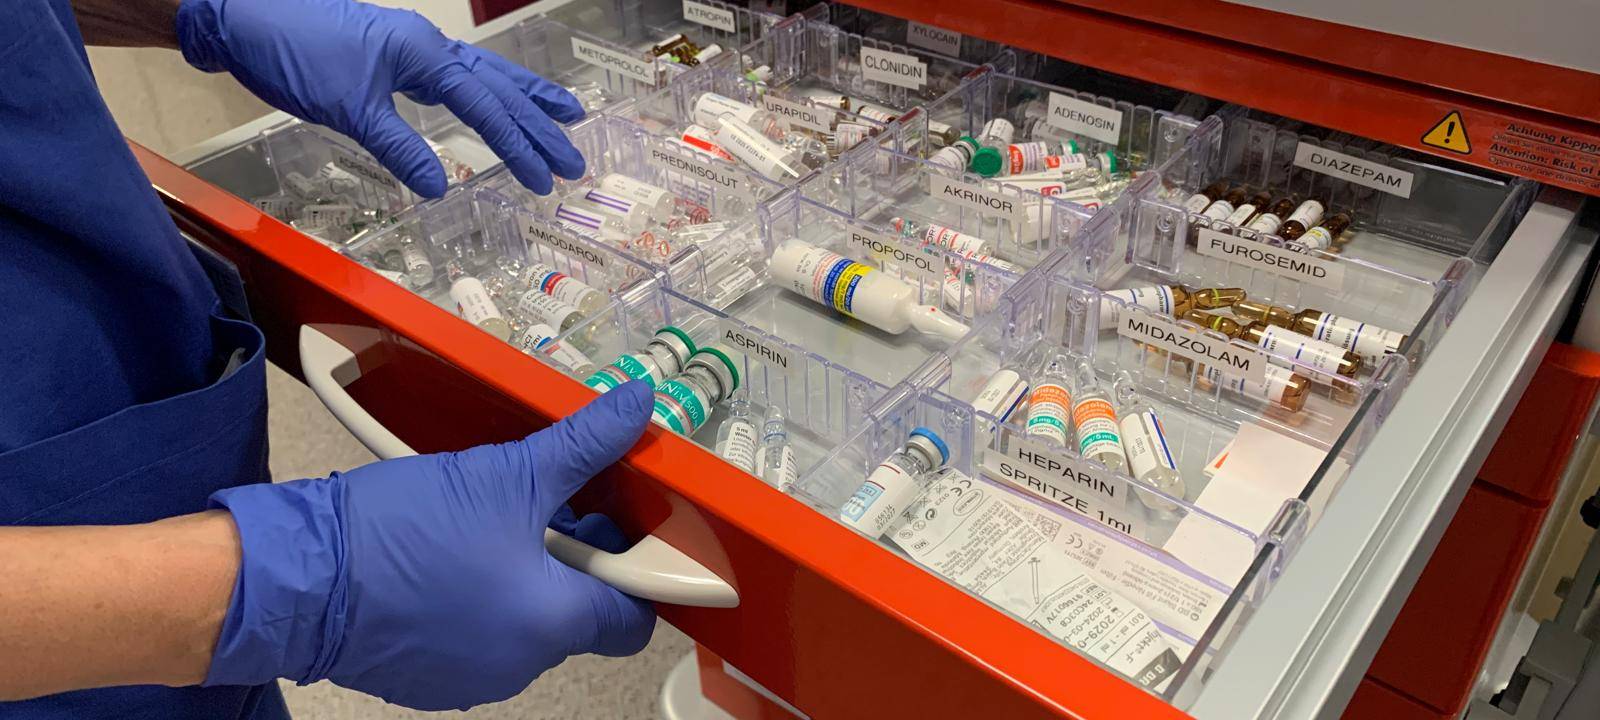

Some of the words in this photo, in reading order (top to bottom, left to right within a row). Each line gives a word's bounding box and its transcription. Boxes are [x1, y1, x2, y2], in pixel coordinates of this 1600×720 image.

[687, 6, 733, 26] ATROPIN
[912, 24, 959, 46] XYLOCAIN
[578, 46, 650, 77] METOPROLOL
[865, 55, 923, 79] CLONIDIN
[766, 103, 821, 125] URAPIDIL
[1054, 106, 1115, 131] ADENOSIN
[1507, 123, 1556, 143] Achtung
[652, 150, 739, 189] PREDNISOLUT
[1310, 153, 1402, 188] DIAZEPAM
[1490, 143, 1548, 164] Attention:
[1552, 157, 1577, 172] Risk
[1581, 165, 1594, 175] of
[944, 185, 1013, 213] AKRINOR
[529, 225, 604, 267] AMIODARON
[851, 233, 936, 273] PROPOFOL
[1210, 238, 1327, 279] FUROSEMID
[725, 330, 787, 368] ASPIRIN
[1127, 318, 1250, 371] MIDAZOLAM
[1018, 448, 1115, 496] HEPARIN
[1000, 464, 1088, 514] SPRITZE
[1097, 510, 1132, 535] 1ml
[1061, 605, 1104, 645] 2024-03-0
[1074, 614, 1115, 652] 2029-0
[1128, 612, 1144, 627] 0.01
